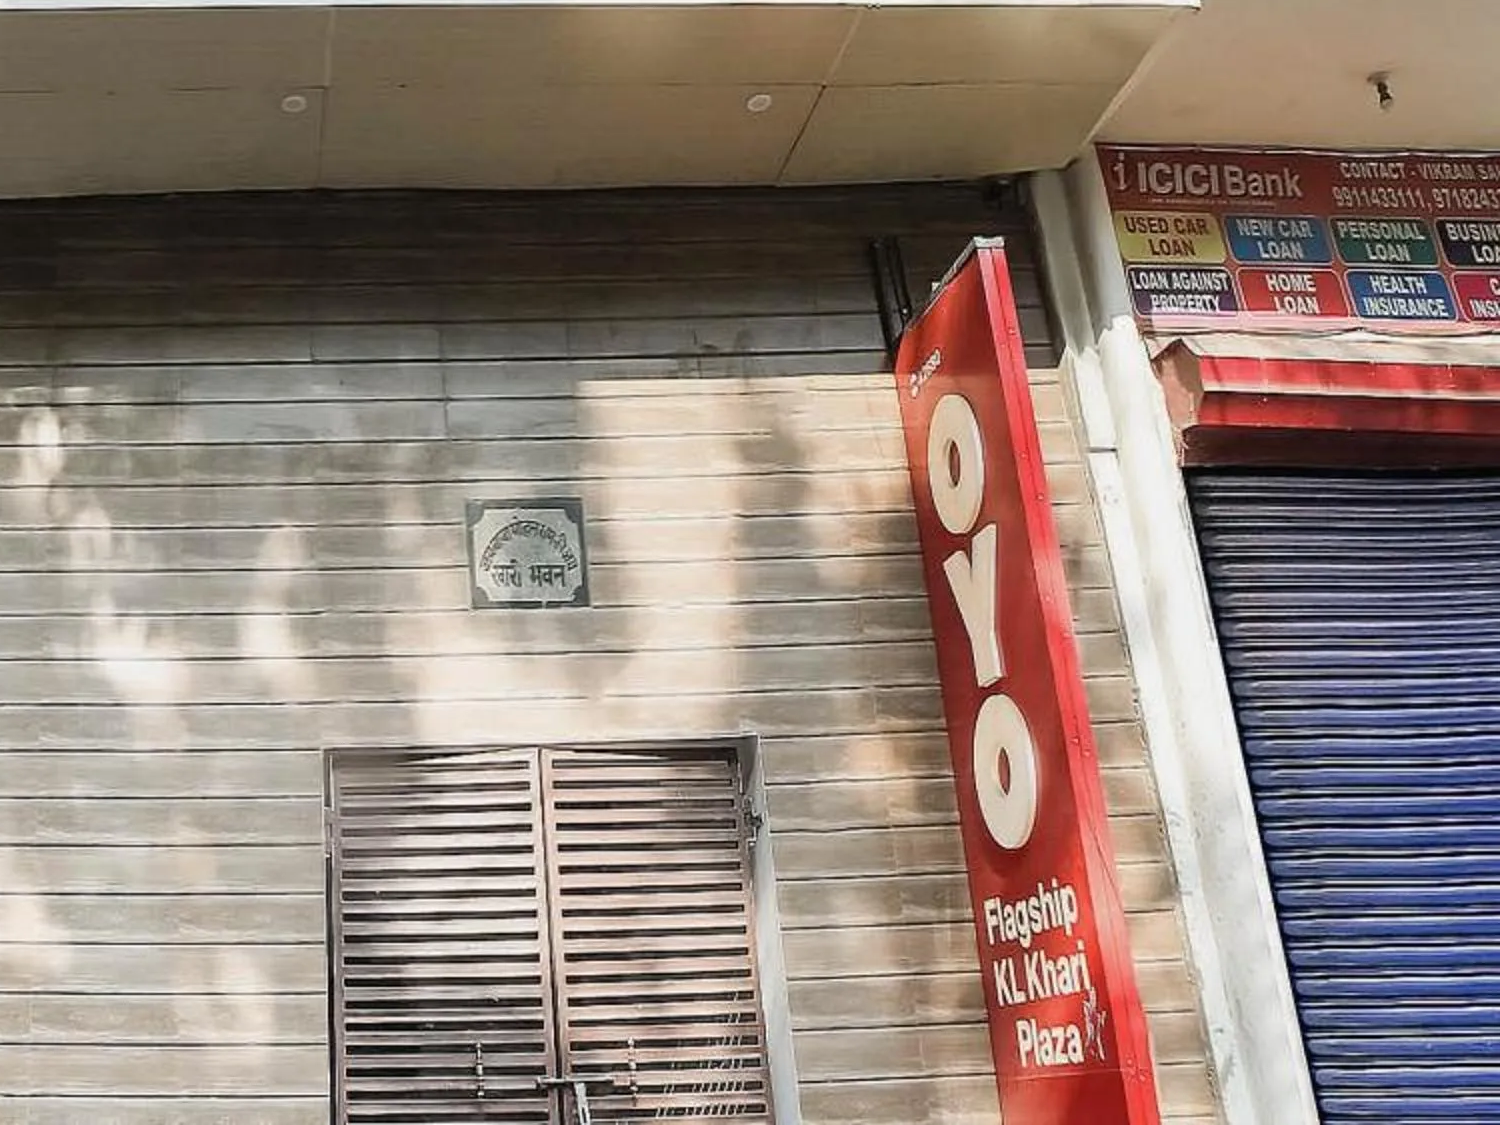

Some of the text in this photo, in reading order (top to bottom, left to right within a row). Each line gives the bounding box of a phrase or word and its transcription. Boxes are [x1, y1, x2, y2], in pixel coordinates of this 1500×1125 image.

[1137, 161, 1220, 195] ICICI
[1223, 164, 1302, 197] Bank
[1339, 162, 1406, 179] CONTACT
[1123, 216, 1210, 236] USED CAR
[1236, 218, 1314, 238] NEW CAR
[1337, 222, 1426, 240] PERSONAL
[1148, 238, 1196, 256] LOAN
[1257, 241, 1304, 260] LOAN
[1365, 243, 1411, 262] LOAN
[1130, 271, 1230, 292] LOAN AGAINST
[1266, 274, 1317, 292] HOME
[1370, 275, 1427, 294] HEALTH
[1150, 293, 1219, 313] PROPERTY
[1273, 295, 1321, 314] LOAN
[1362, 297, 1449, 316] INSURANCE
[528, 564, 566, 587] भवन
[927, 393, 1039, 850] OYO
[983, 877, 1079, 948] Flagship
[993, 939, 1091, 1007] KL Khari
[1016, 1018, 1085, 1068] Plaza
